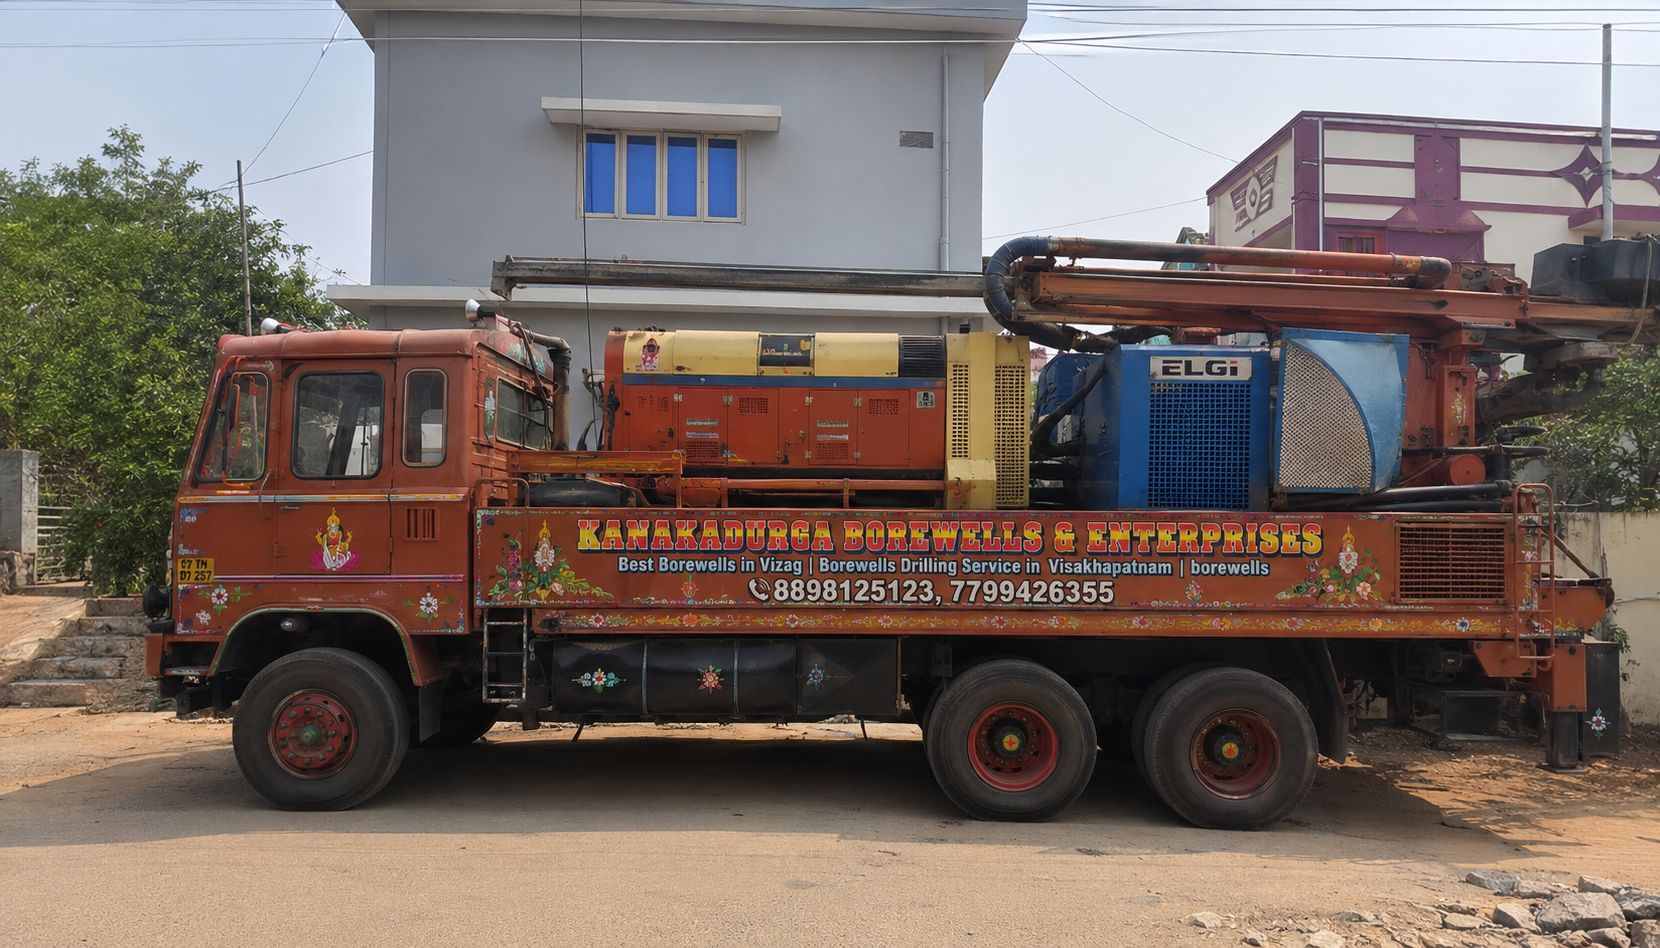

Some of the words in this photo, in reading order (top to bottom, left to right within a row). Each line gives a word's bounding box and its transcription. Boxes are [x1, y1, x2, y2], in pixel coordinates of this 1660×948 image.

[1162, 360, 1238, 376] ELGi
[577, 519, 835, 553] KANAKADURGA
[843, 520, 1044, 555] BOREWELLS
[1053, 521, 1076, 554] &
[1086, 521, 1323, 556] ENTERPRISES
[195, 559, 208, 569] TN
[618, 556, 654, 572] Best
[659, 556, 736, 572] Borewells
[741, 556, 755, 572] in
[760, 557, 803, 575] Vizag
[819, 557, 897, 573] Borewells
[901, 557, 957, 576] Drilling
[962, 557, 1021, 574] Service
[1026, 558, 1041, 574] in
[1048, 558, 1172, 577] Visakhapatnam
[1190, 559, 1270, 575] borewells
[773, 578, 942, 606] 8898125123,
[950, 580, 1115, 603] 7799426355
